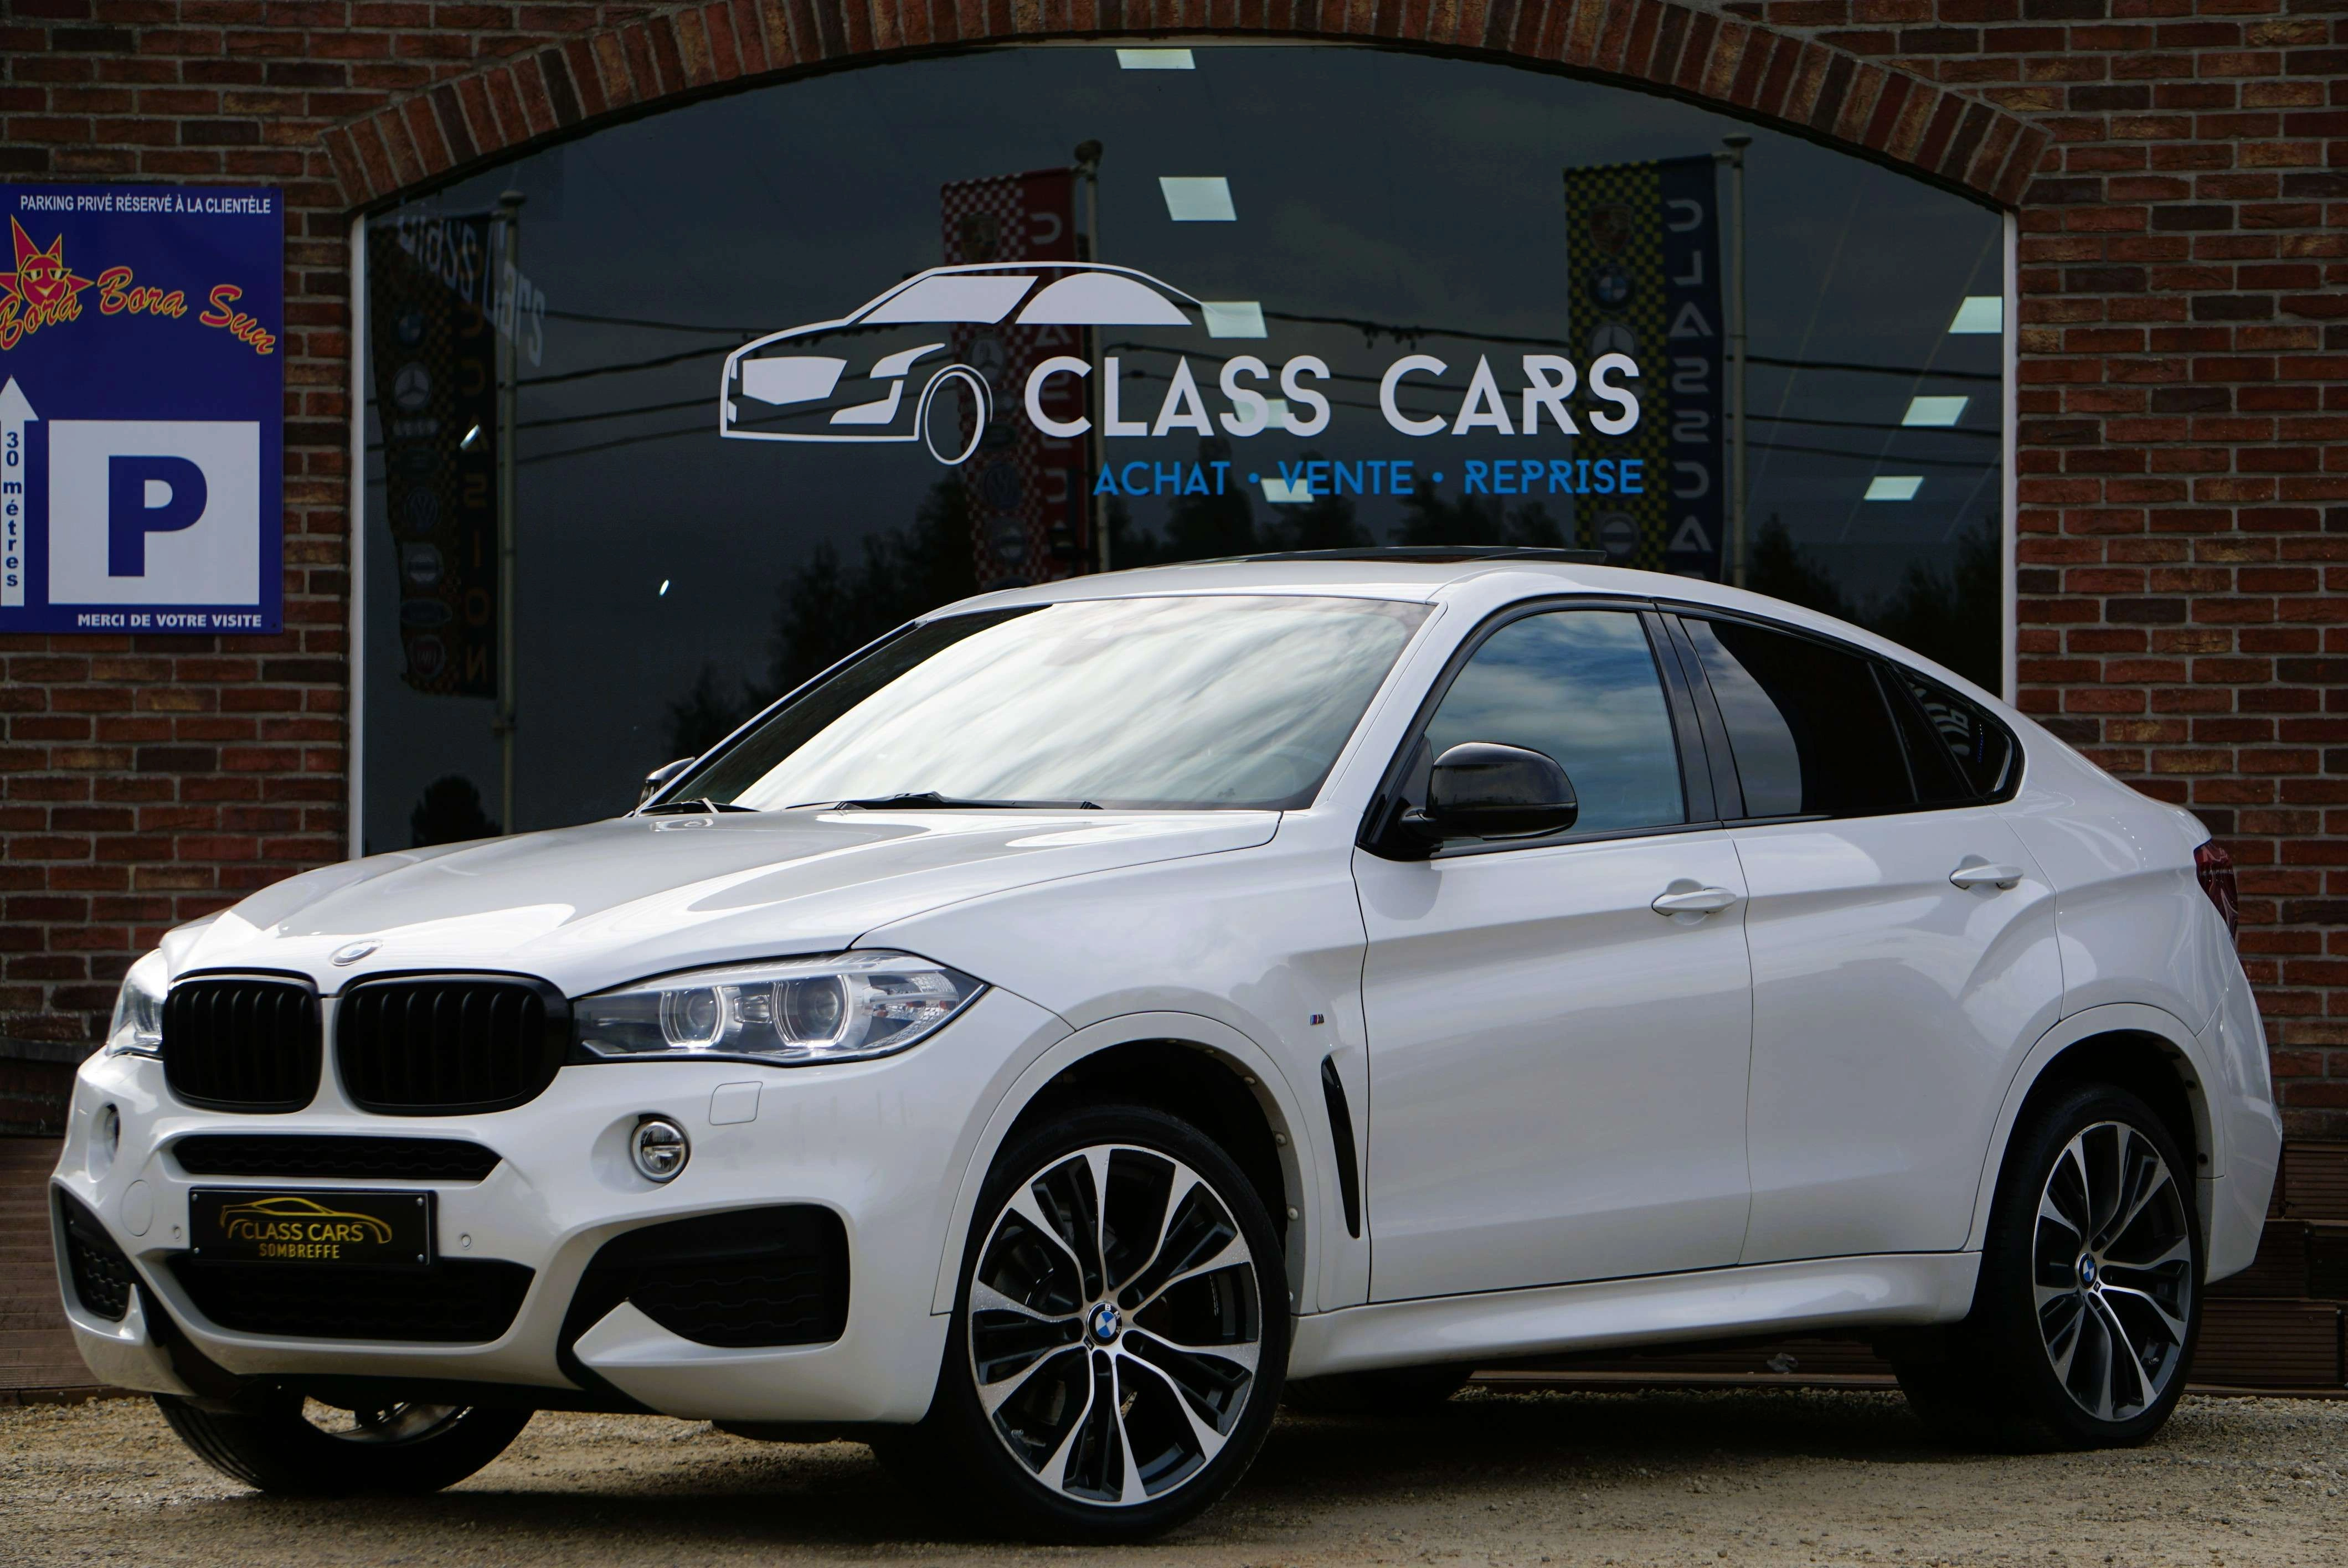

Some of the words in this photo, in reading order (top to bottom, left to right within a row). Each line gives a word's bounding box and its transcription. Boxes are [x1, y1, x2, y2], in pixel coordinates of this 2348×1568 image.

[20, 195, 74, 211] PARKING
[78, 193, 112, 211] PRIVÉ
[116, 194, 172, 213] RÉSERVÉ
[175, 194, 184, 213] À
[187, 198, 203, 213] LA
[205, 195, 271, 214] CLIENTÈLE
[0, 292, 83, 350] Bora
[97, 266, 187, 318] Bora
[199, 284, 275, 354] Sun
[1024, 354, 1330, 437] CLASS
[1379, 353, 1640, 436] CARS
[6, 431, 19, 467] 30
[1093, 461, 1230, 496] ACHAT
[1278, 461, 1414, 494] VENTE
[1464, 459, 1644, 494] REPRISE
[109, 455, 208, 577] P
[78, 614, 125, 627] MERCI
[130, 614, 151, 627] DE
[156, 614, 207, 627] VOTRE
[213, 614, 262, 627] VISITE
[242, 1222, 303, 1241] CLASS
[307, 1223, 364, 1242] CARS
[259, 1244, 341, 1259] SOMBREFFE
